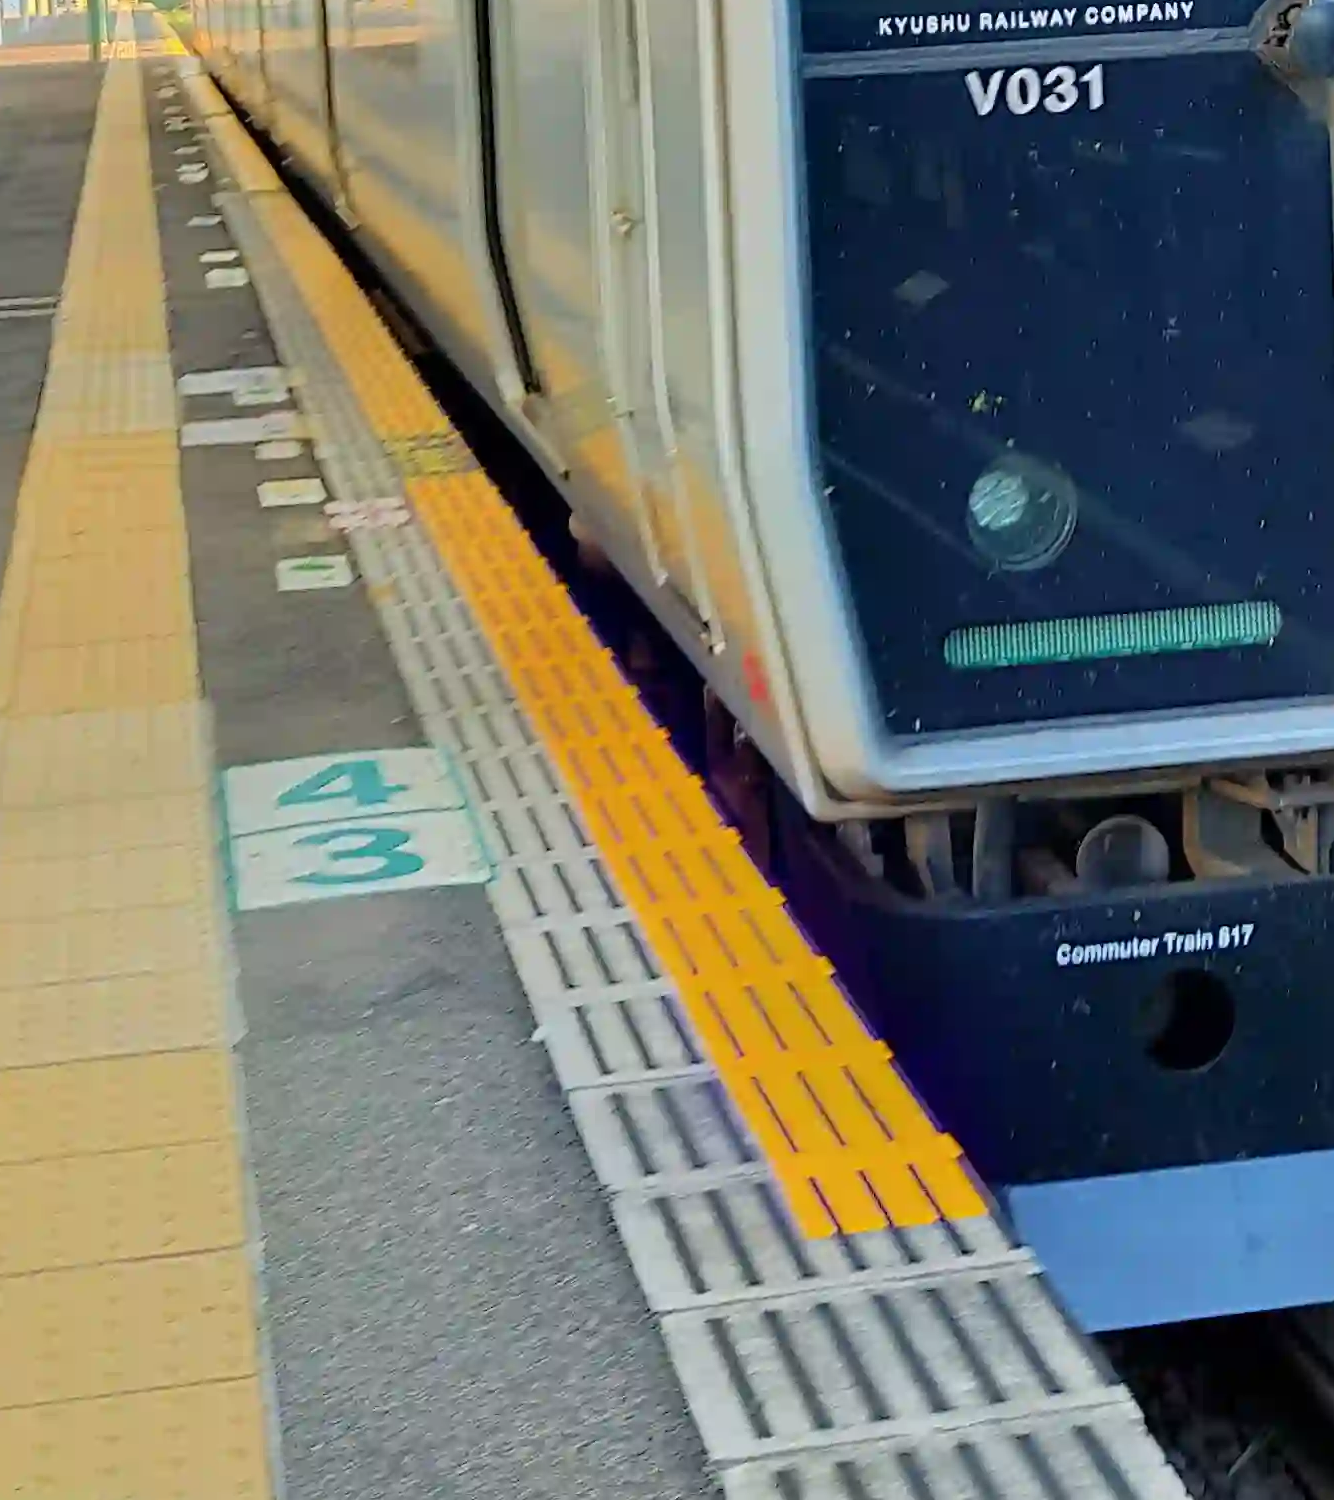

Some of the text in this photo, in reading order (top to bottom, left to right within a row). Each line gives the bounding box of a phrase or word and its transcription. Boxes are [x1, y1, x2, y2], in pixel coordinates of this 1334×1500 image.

[878, 0, 1195, 36] KYUSHU RAILWAY COMPANY
[964, 63, 1105, 116] V031
[275, 759, 410, 808] 4
[285, 827, 425, 886] 3
[1056, 923, 1255, 967] Commuter Train 817
